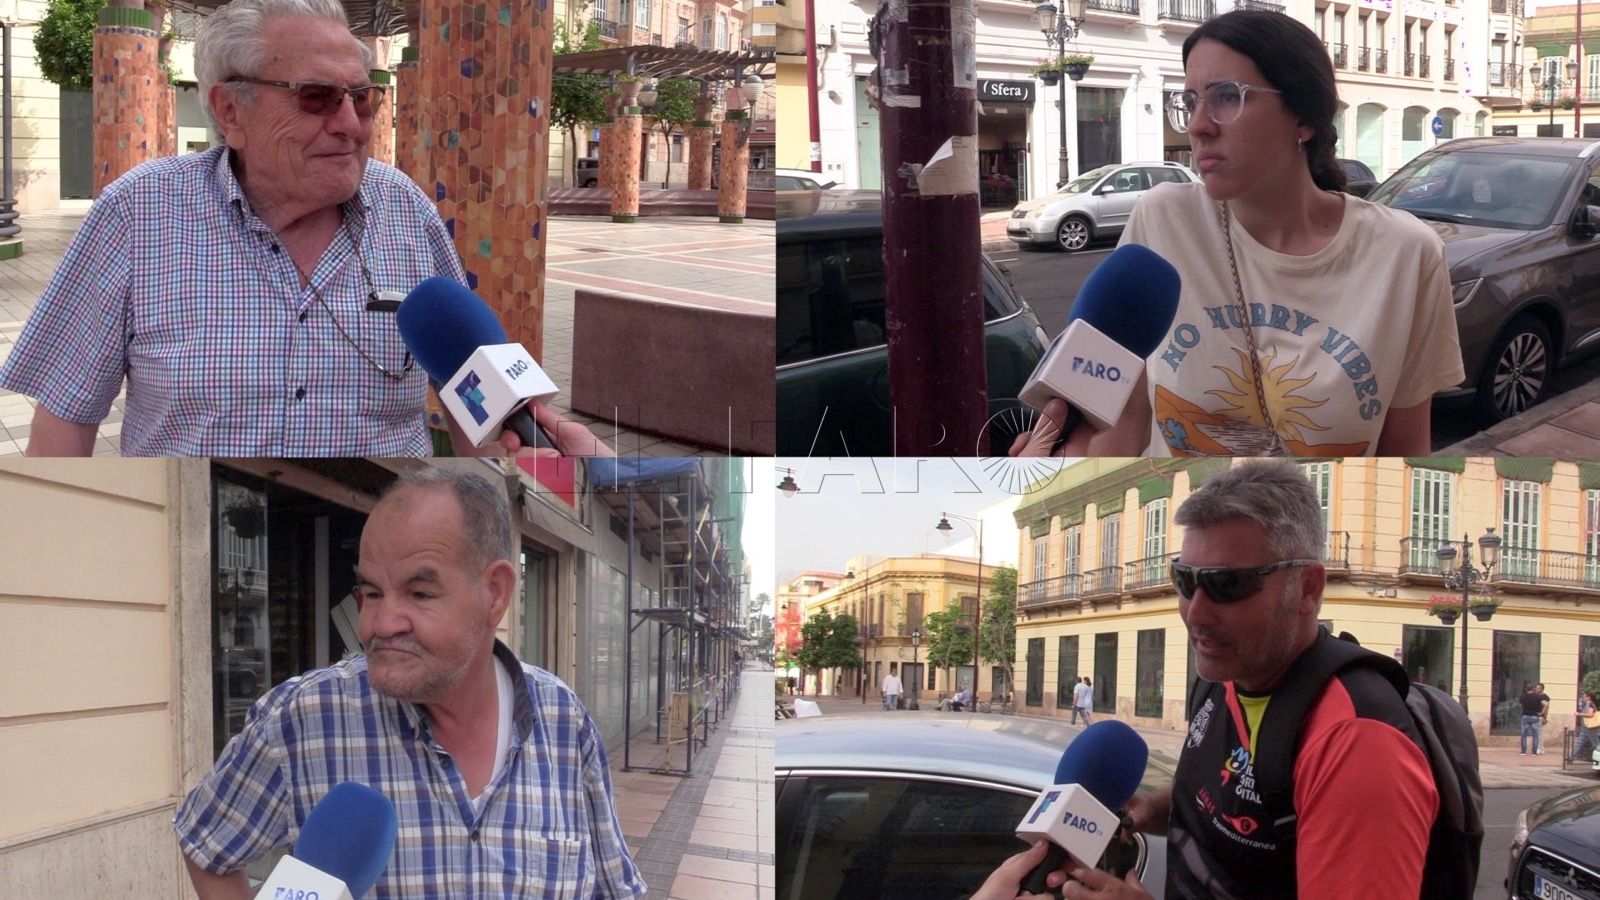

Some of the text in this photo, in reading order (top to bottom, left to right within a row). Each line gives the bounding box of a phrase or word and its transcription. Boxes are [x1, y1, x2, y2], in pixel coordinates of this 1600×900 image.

[1072, 357, 1121, 382] FARO
[1161, 303, 1382, 421] NO HURRY VIBES
[1062, 812, 1098, 834] FARO
